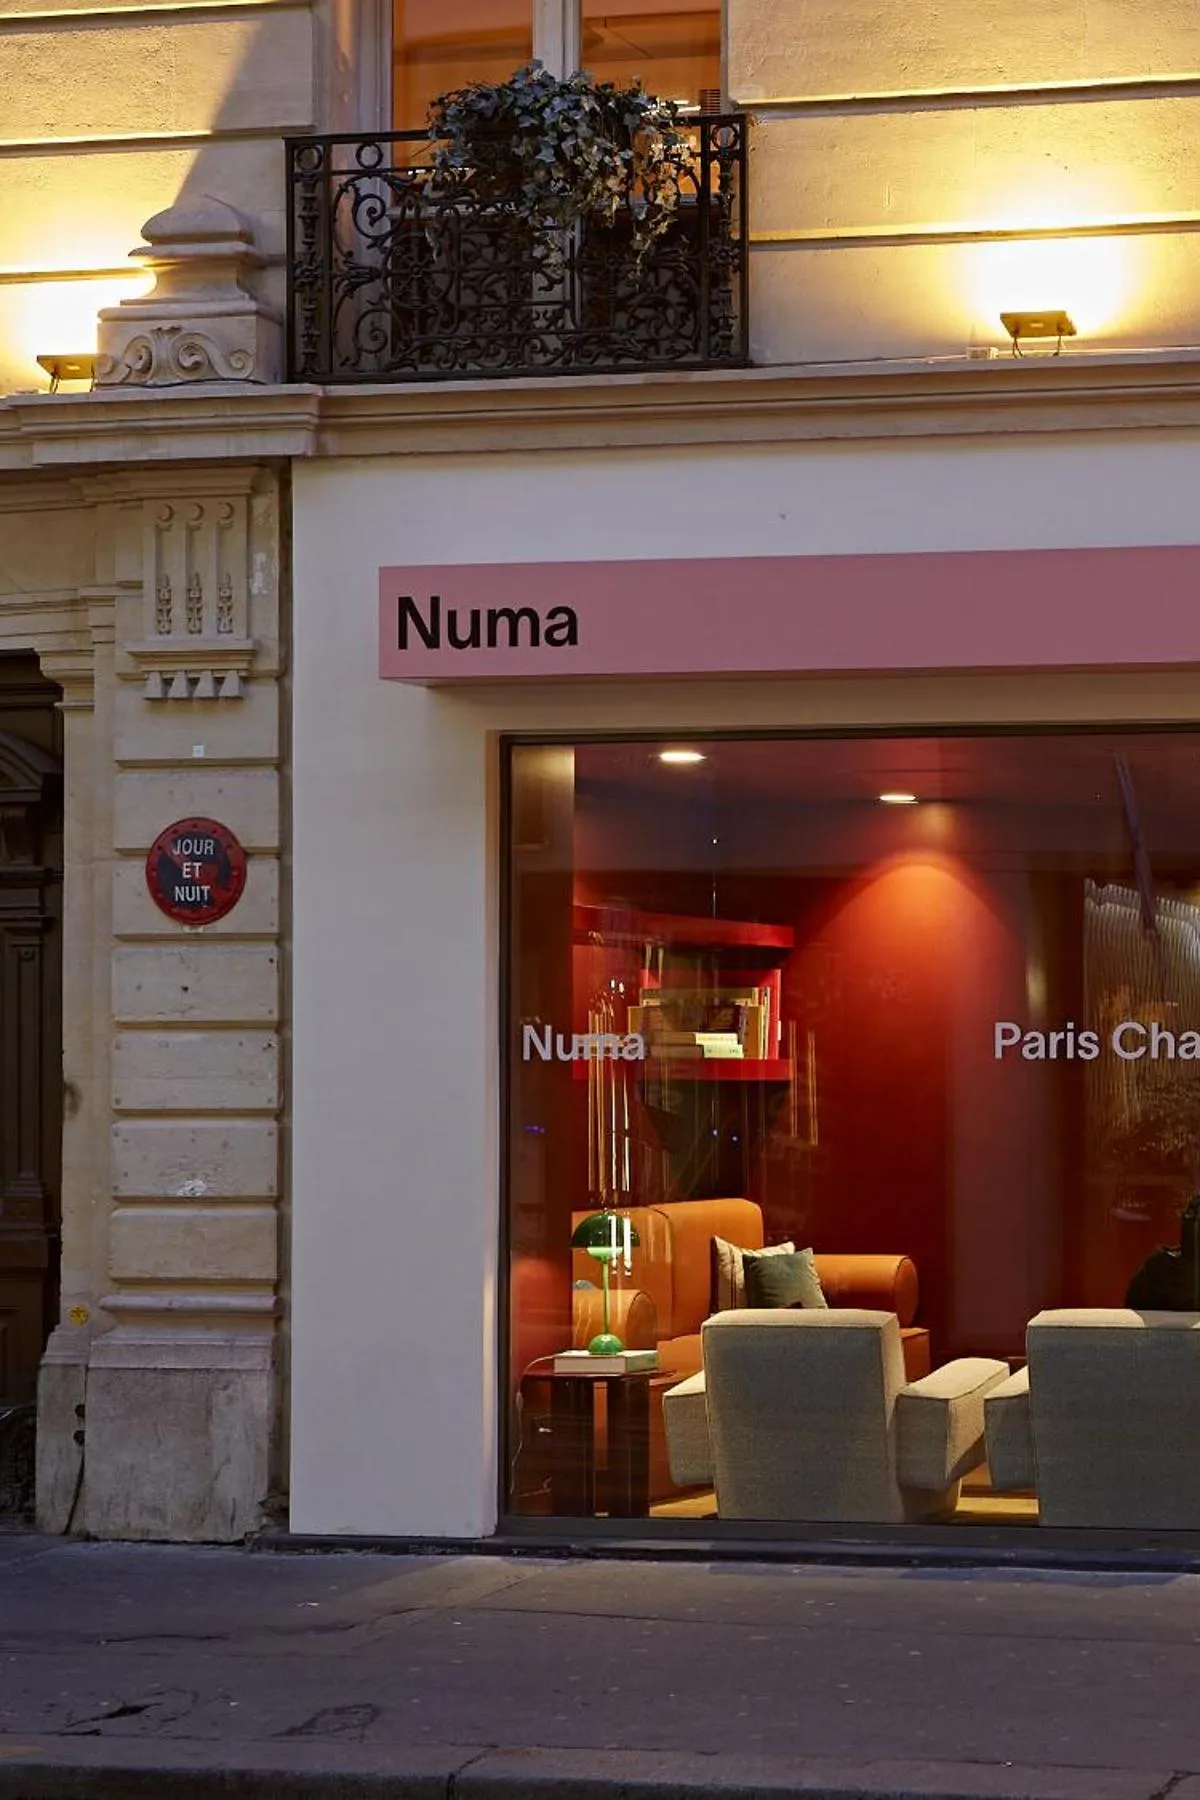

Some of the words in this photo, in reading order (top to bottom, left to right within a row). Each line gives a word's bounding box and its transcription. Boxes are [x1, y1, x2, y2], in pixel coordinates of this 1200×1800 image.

[397, 596, 578, 651] Numa
[172, 839, 214, 855] JOUR
[182, 862, 202, 878] ET
[175, 886, 211, 902] NUIT
[522, 1024, 645, 1061] Numa
[994, 1021, 1099, 1060] Paris
